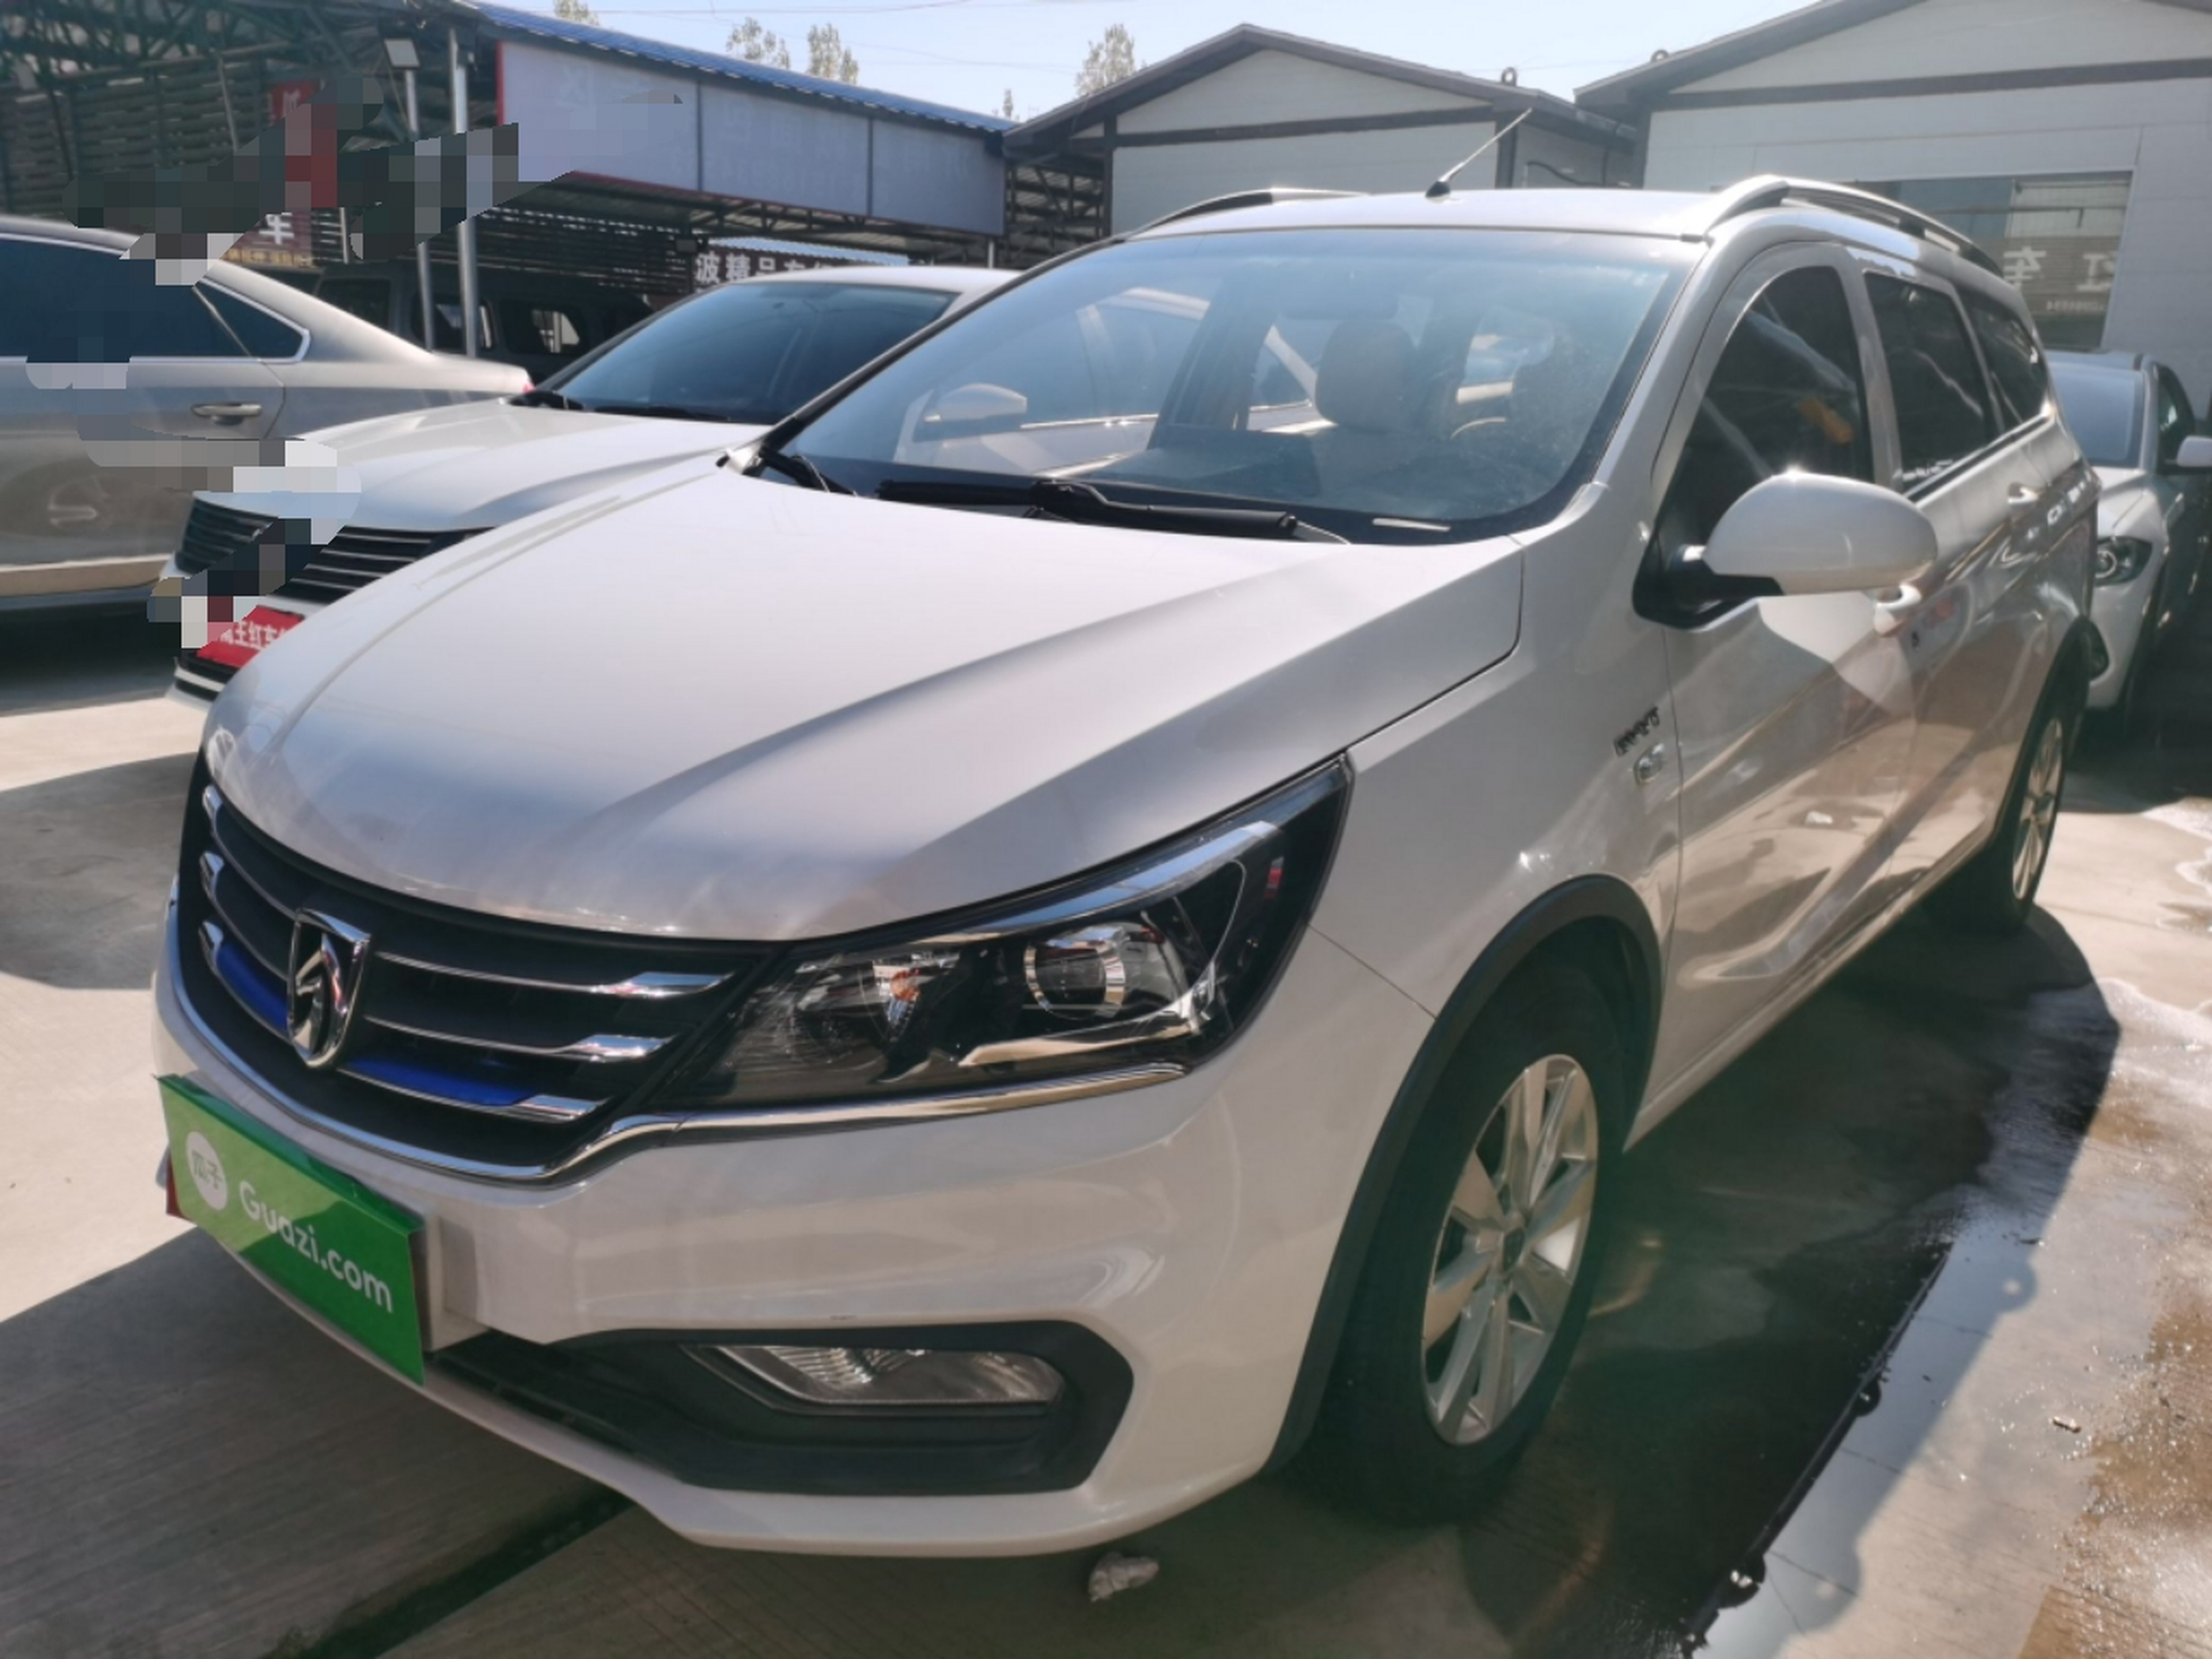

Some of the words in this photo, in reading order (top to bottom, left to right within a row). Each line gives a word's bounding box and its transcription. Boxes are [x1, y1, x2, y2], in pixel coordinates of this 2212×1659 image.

[695, 250, 833, 285] 波精品
[239, 1180, 393, 1313] Guazi.com
